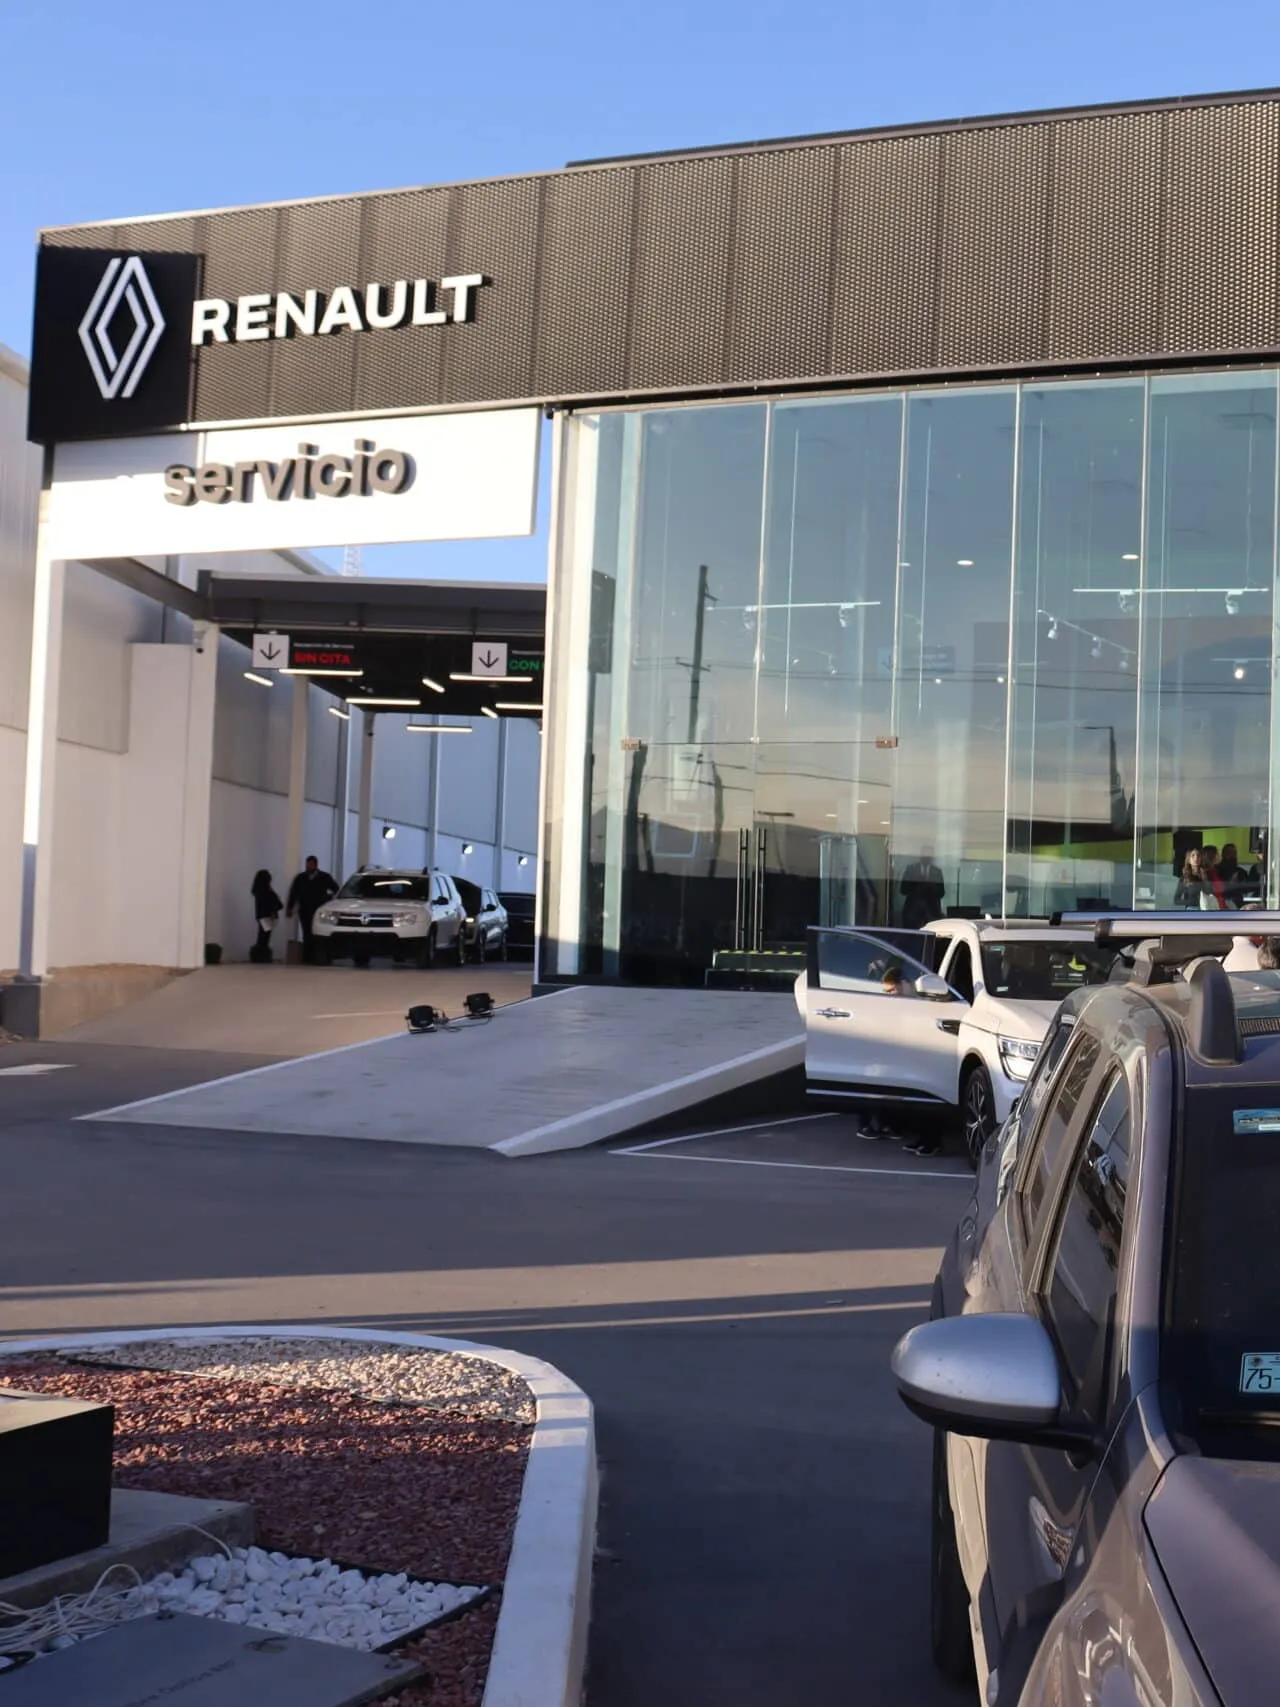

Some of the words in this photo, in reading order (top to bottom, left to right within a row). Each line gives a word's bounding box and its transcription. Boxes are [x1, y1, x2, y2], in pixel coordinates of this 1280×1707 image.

[191, 274, 483, 345] RENAULT
[164, 438, 413, 506] servicio
[320, 653, 351, 665] CITA
[508, 660, 540, 671] CON
